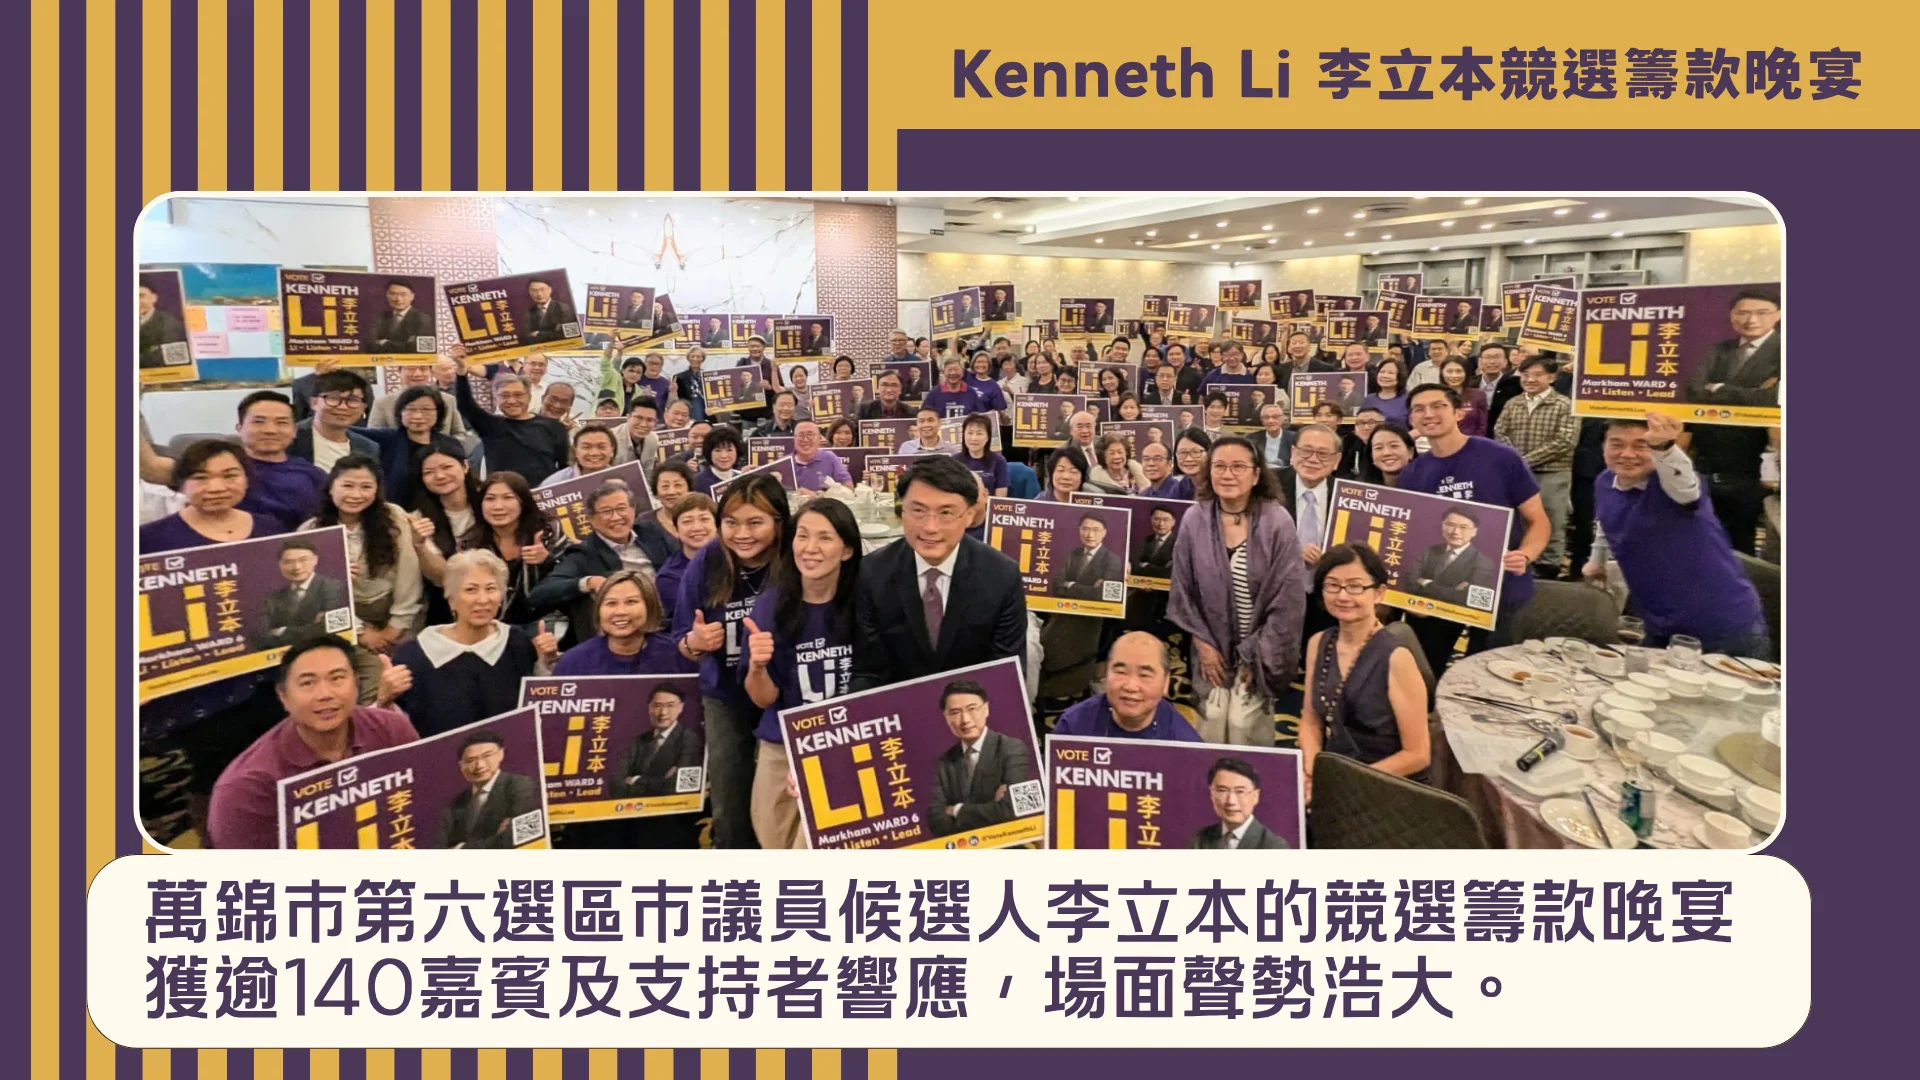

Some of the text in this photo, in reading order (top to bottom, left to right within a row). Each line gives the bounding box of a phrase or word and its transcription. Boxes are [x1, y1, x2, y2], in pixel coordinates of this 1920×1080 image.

[285, 283, 359, 296] KENNETH
[450, 289, 508, 306] KENNETH
[1586, 295, 1617, 305] VOTE
[588, 296, 610, 318] Li
[1504, 293, 1527, 313] Li
[1534, 294, 1579, 307] KENNETH
[287, 295, 338, 336] Li
[454, 301, 499, 340] Li
[932, 305, 949, 326] Li
[1061, 308, 1079, 326] Li
[1169, 310, 1185, 326] Li
[1416, 307, 1438, 326] Li
[1527, 302, 1562, 331] Li
[1585, 305, 1685, 321] KENNETH
[775, 330, 794, 350] Li
[1329, 321, 1349, 339] Li
[1583, 322, 1650, 377] Li
[1655, 321, 1682, 377] 李立本
[705, 380, 726, 400] Li
[1080, 372, 1099, 391] Li
[1581, 379, 1678, 389] Markham WARD 6
[1295, 386, 1317, 408] Li
[1581, 387, 1676, 399] Li Listen Lead
[813, 395, 834, 417] Li
[1016, 407, 1039, 430] Li
[1341, 487, 1363, 497] VOTE
[1436, 480, 1473, 493] ENNETH
[536, 490, 583, 511] ENNETH
[993, 504, 1014, 513] VOTE
[1338, 496, 1412, 520] KENNETH
[992, 513, 1055, 530] KENNETH
[1035, 530, 1053, 575] 李立本
[1384, 520, 1409, 566] 李立本
[212, 579, 244, 633] 李立本
[139, 584, 210, 652] Li
[796, 644, 853, 663] KENNETH
[798, 658, 835, 701] Li
[529, 686, 560, 696] VOTE
[791, 715, 826, 731] VOTE
[586, 715, 612, 774] 李立本
[796, 714, 902, 755] KENNETH
[1056, 749, 1089, 761] VOTE
[879, 737, 916, 810] 李立本
[1055, 766, 1164, 791] KENNETH
[292, 777, 333, 799] VOTE
[292, 767, 415, 825] KENNETH
[801, 743, 884, 831] Li
[818, 813, 920, 846] Markham WARD 6
[1137, 794, 1162, 849] 李立
[891, 825, 922, 841] Lead
